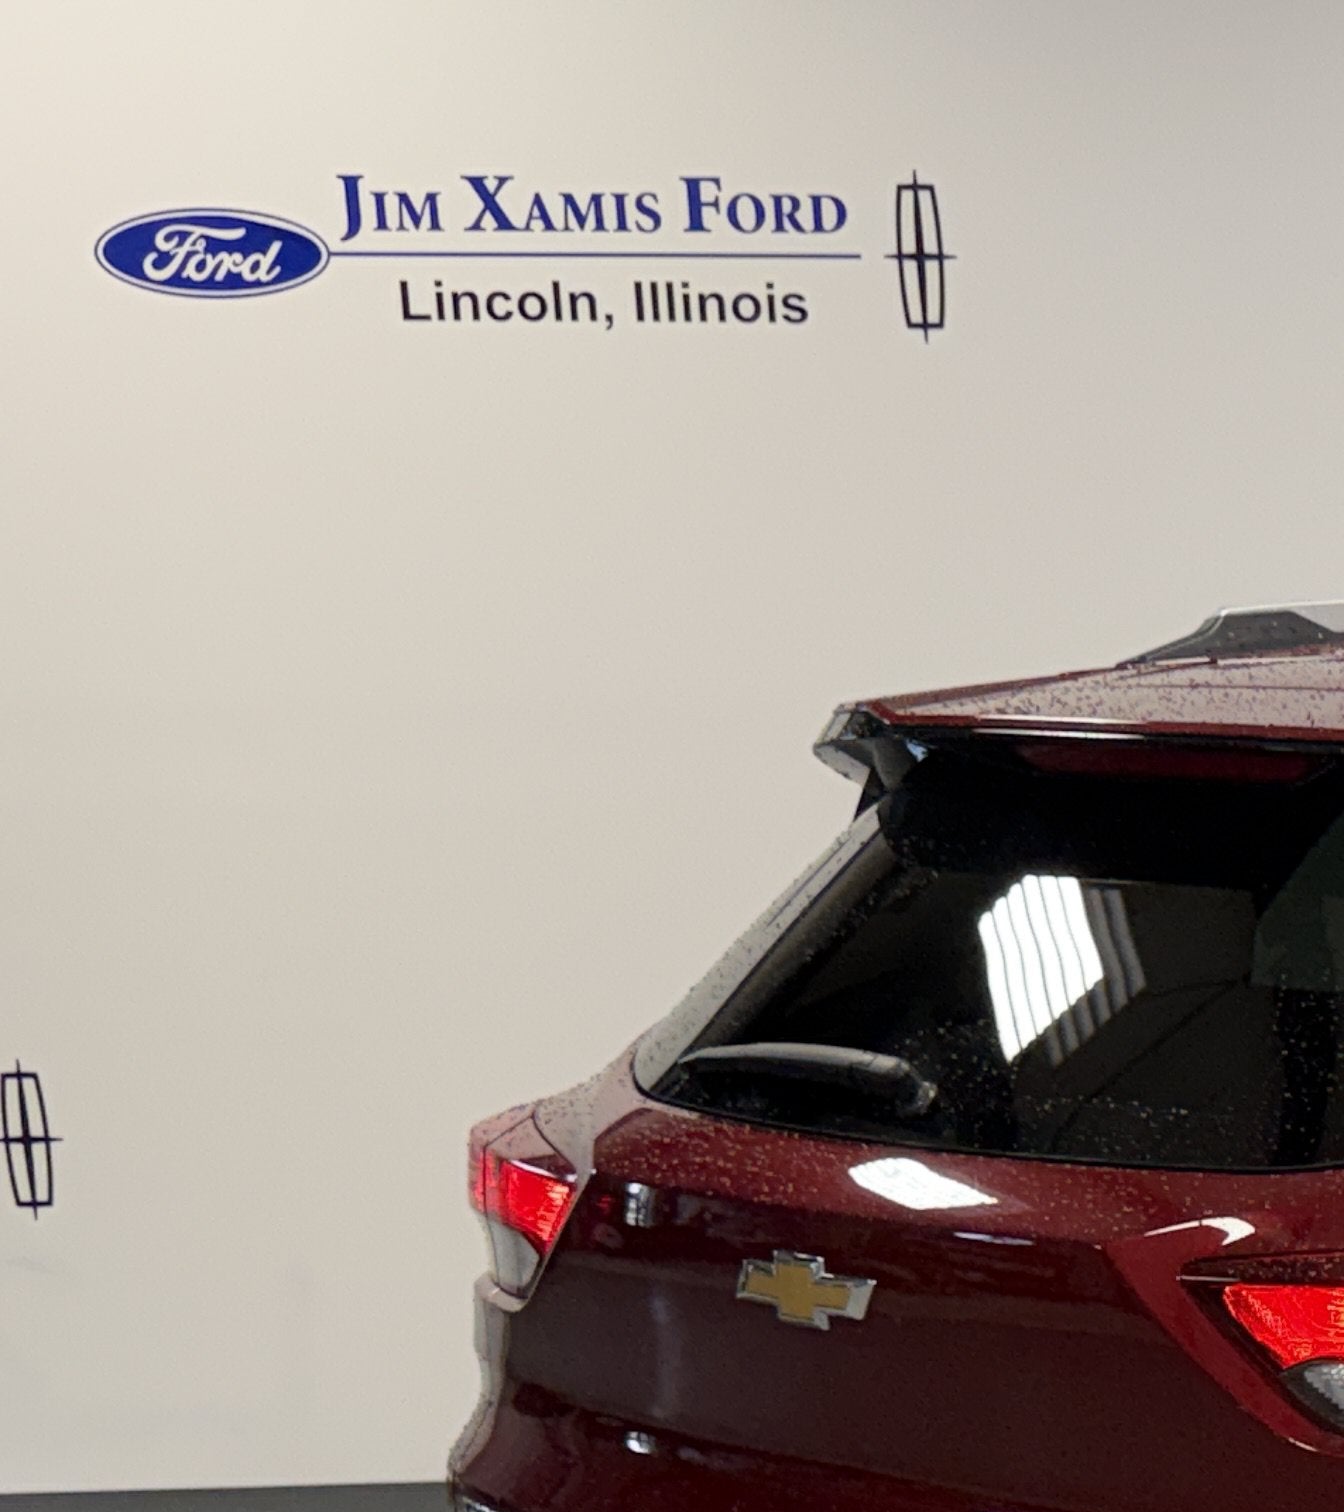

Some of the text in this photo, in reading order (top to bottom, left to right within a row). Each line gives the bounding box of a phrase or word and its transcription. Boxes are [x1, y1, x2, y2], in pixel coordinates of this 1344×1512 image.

[337, 174, 848, 242] JIM XAMIS FORD
[142, 222, 282, 285] Ford
[399, 279, 809, 331] Lincoln, Illinois
